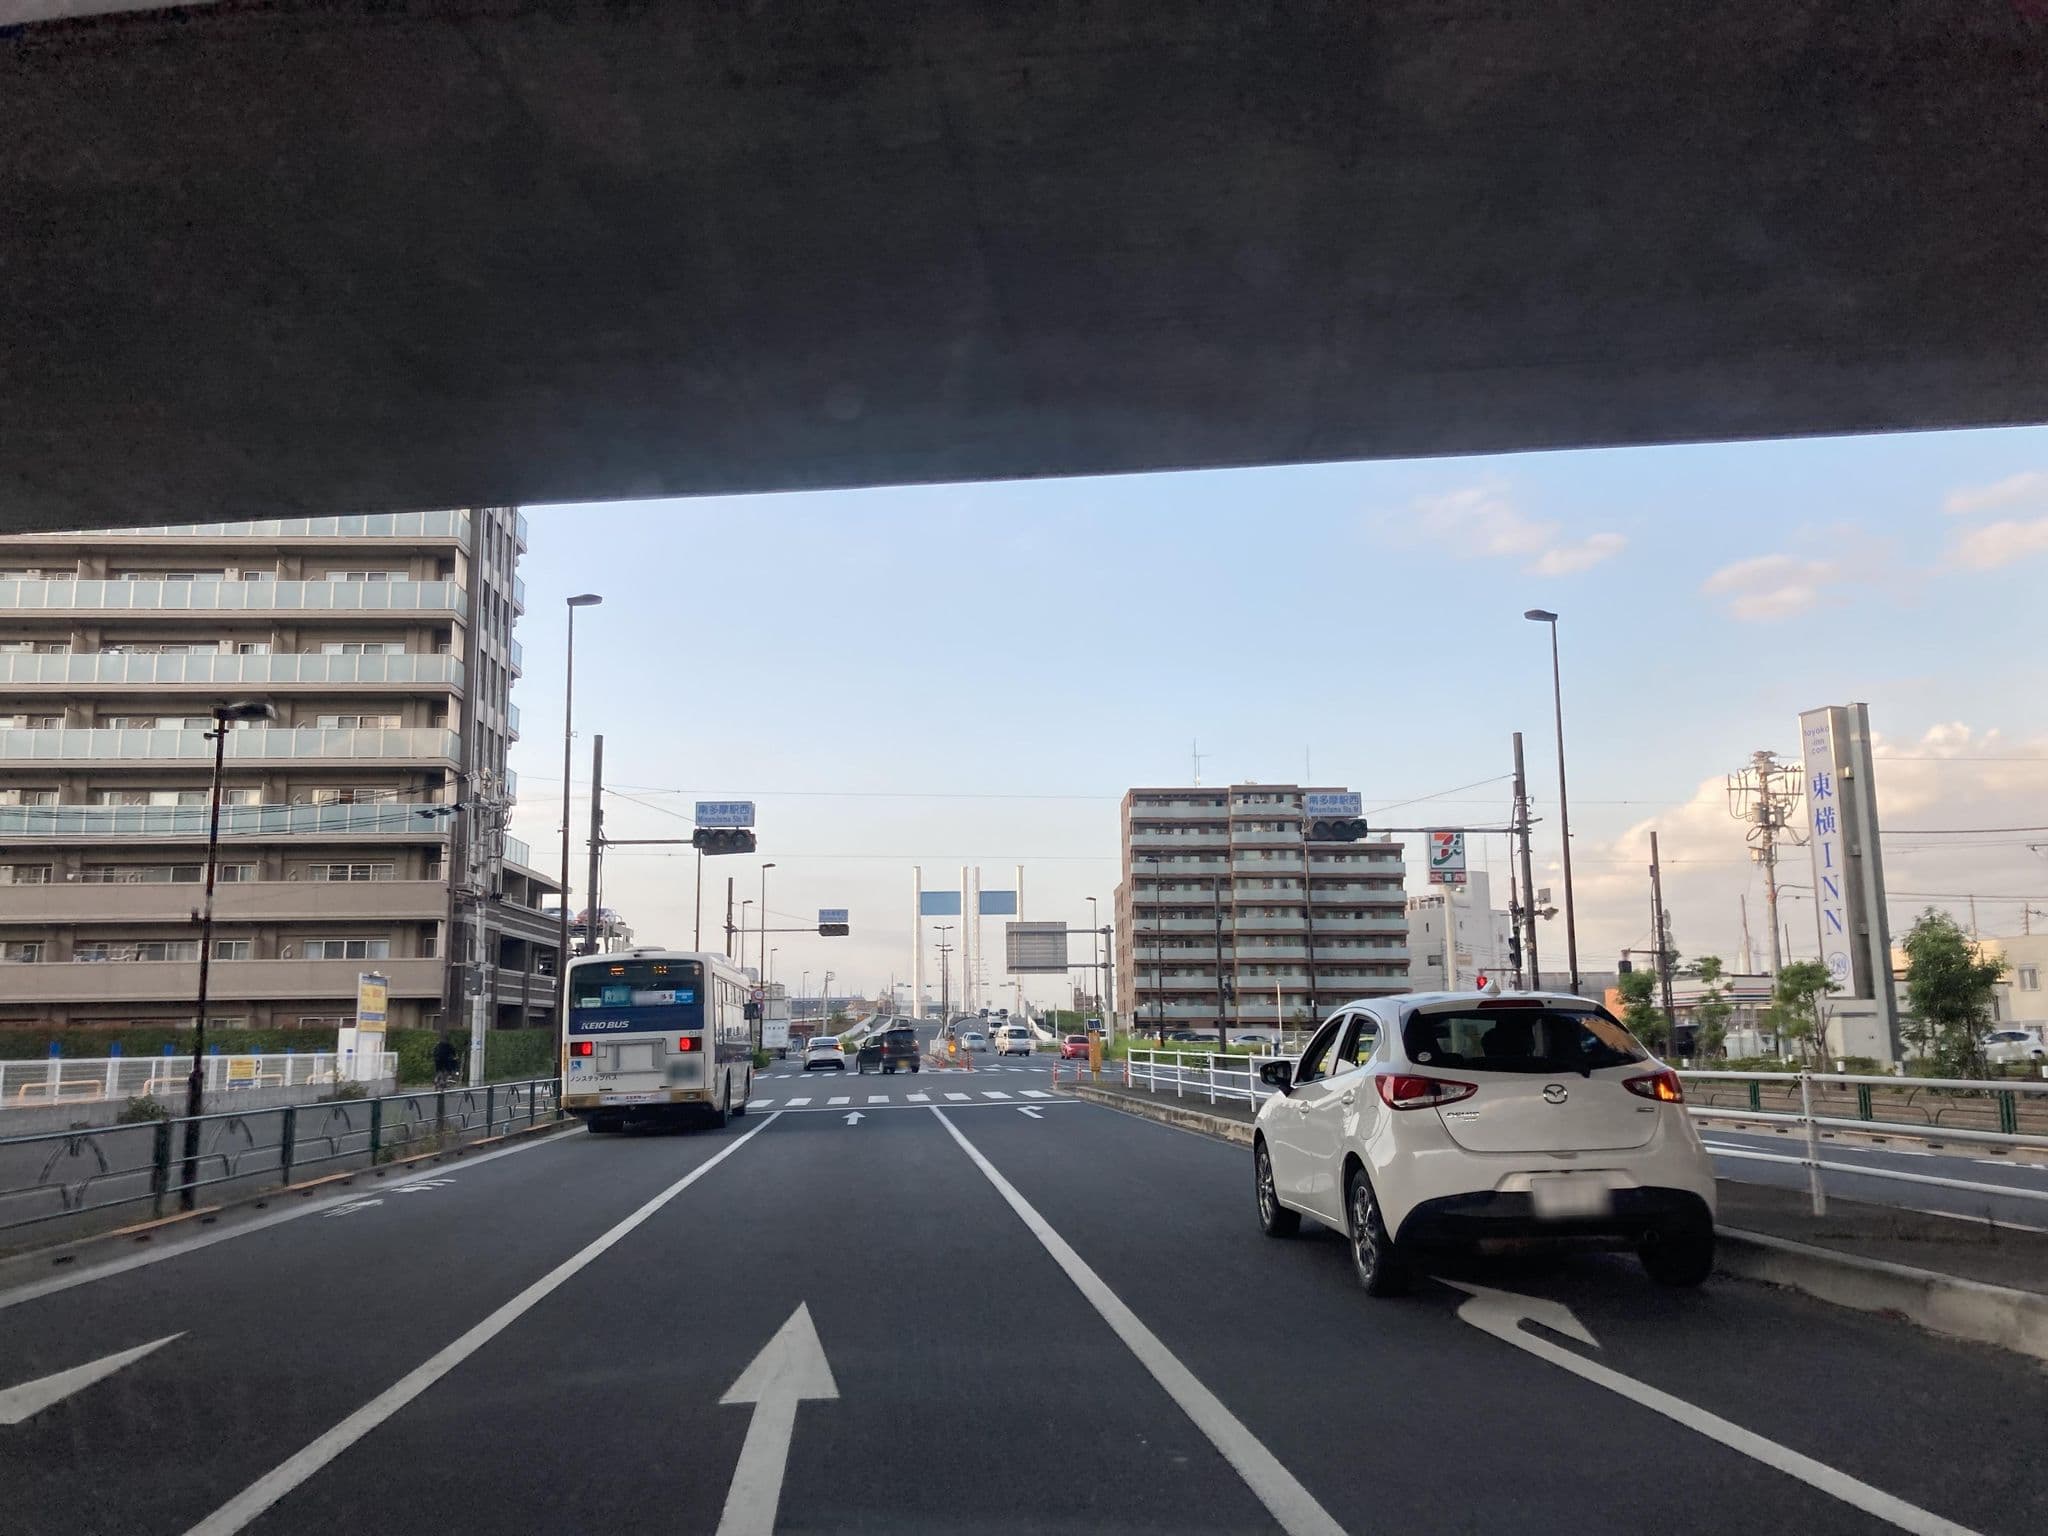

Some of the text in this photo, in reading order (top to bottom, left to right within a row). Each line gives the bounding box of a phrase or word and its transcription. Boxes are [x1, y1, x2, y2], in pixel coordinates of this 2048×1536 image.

[1309, 795, 1359, 805] 南多摩駅西
[1812, 772, 1843, 936] 東横INN
[581, 1020, 629, 1030] KEIO BUS
